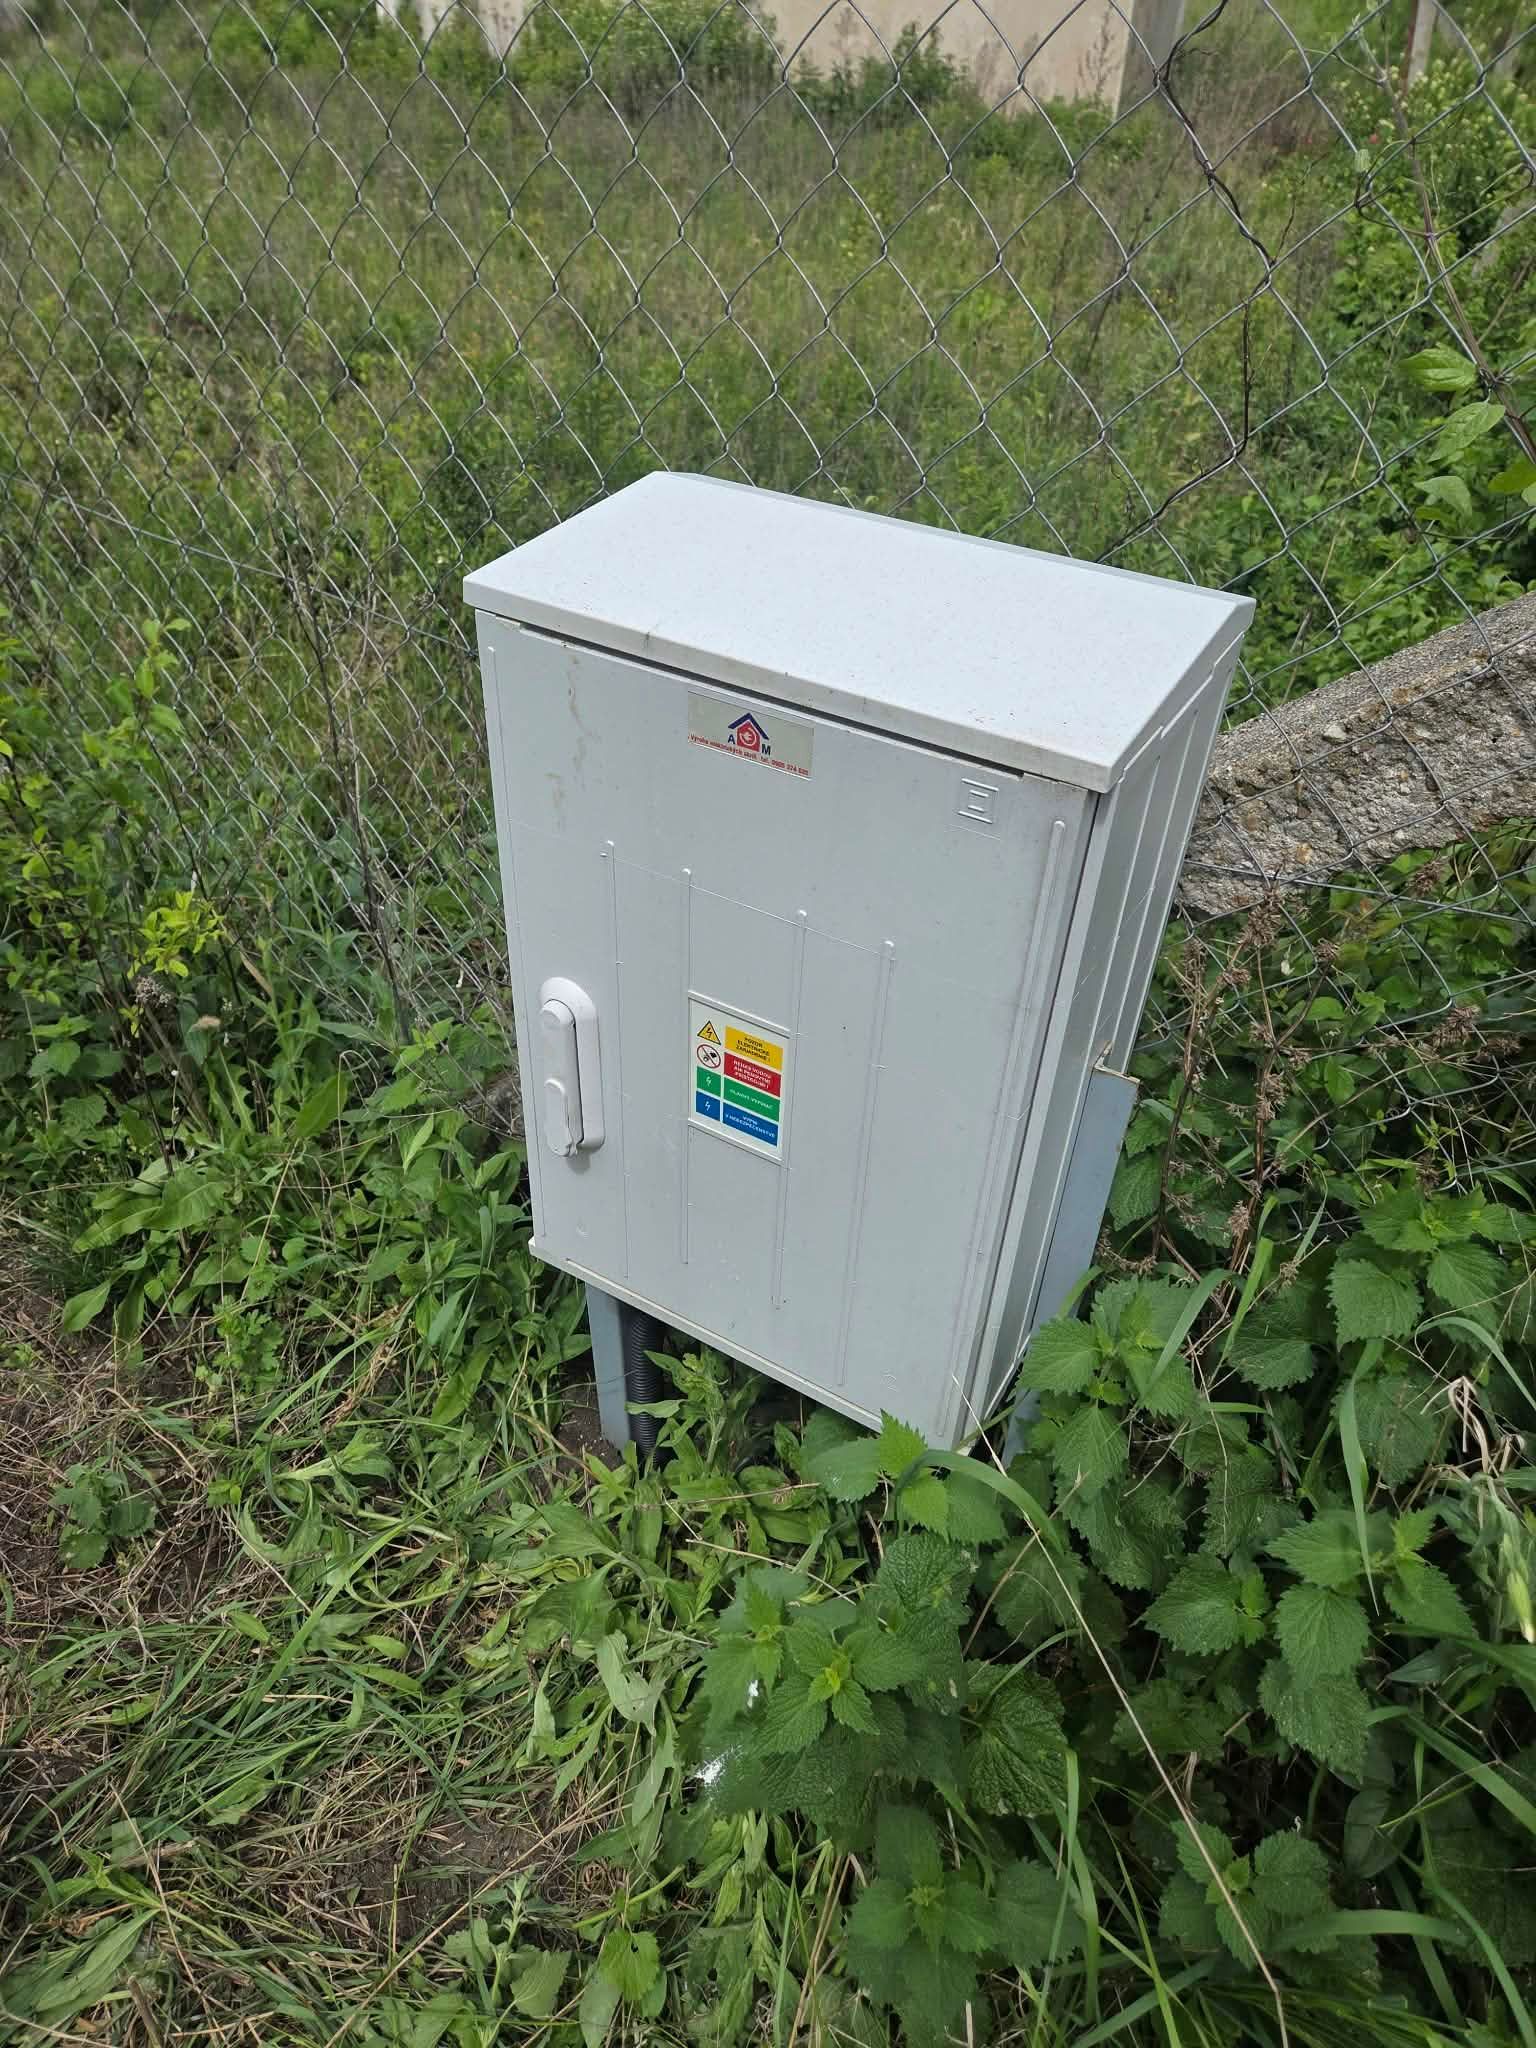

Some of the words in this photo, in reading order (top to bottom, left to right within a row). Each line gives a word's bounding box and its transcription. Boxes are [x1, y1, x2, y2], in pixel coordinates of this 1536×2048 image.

[728, 734, 736, 745] A
[762, 743, 771, 756] M
[744, 1037, 763, 1049] POZOR
